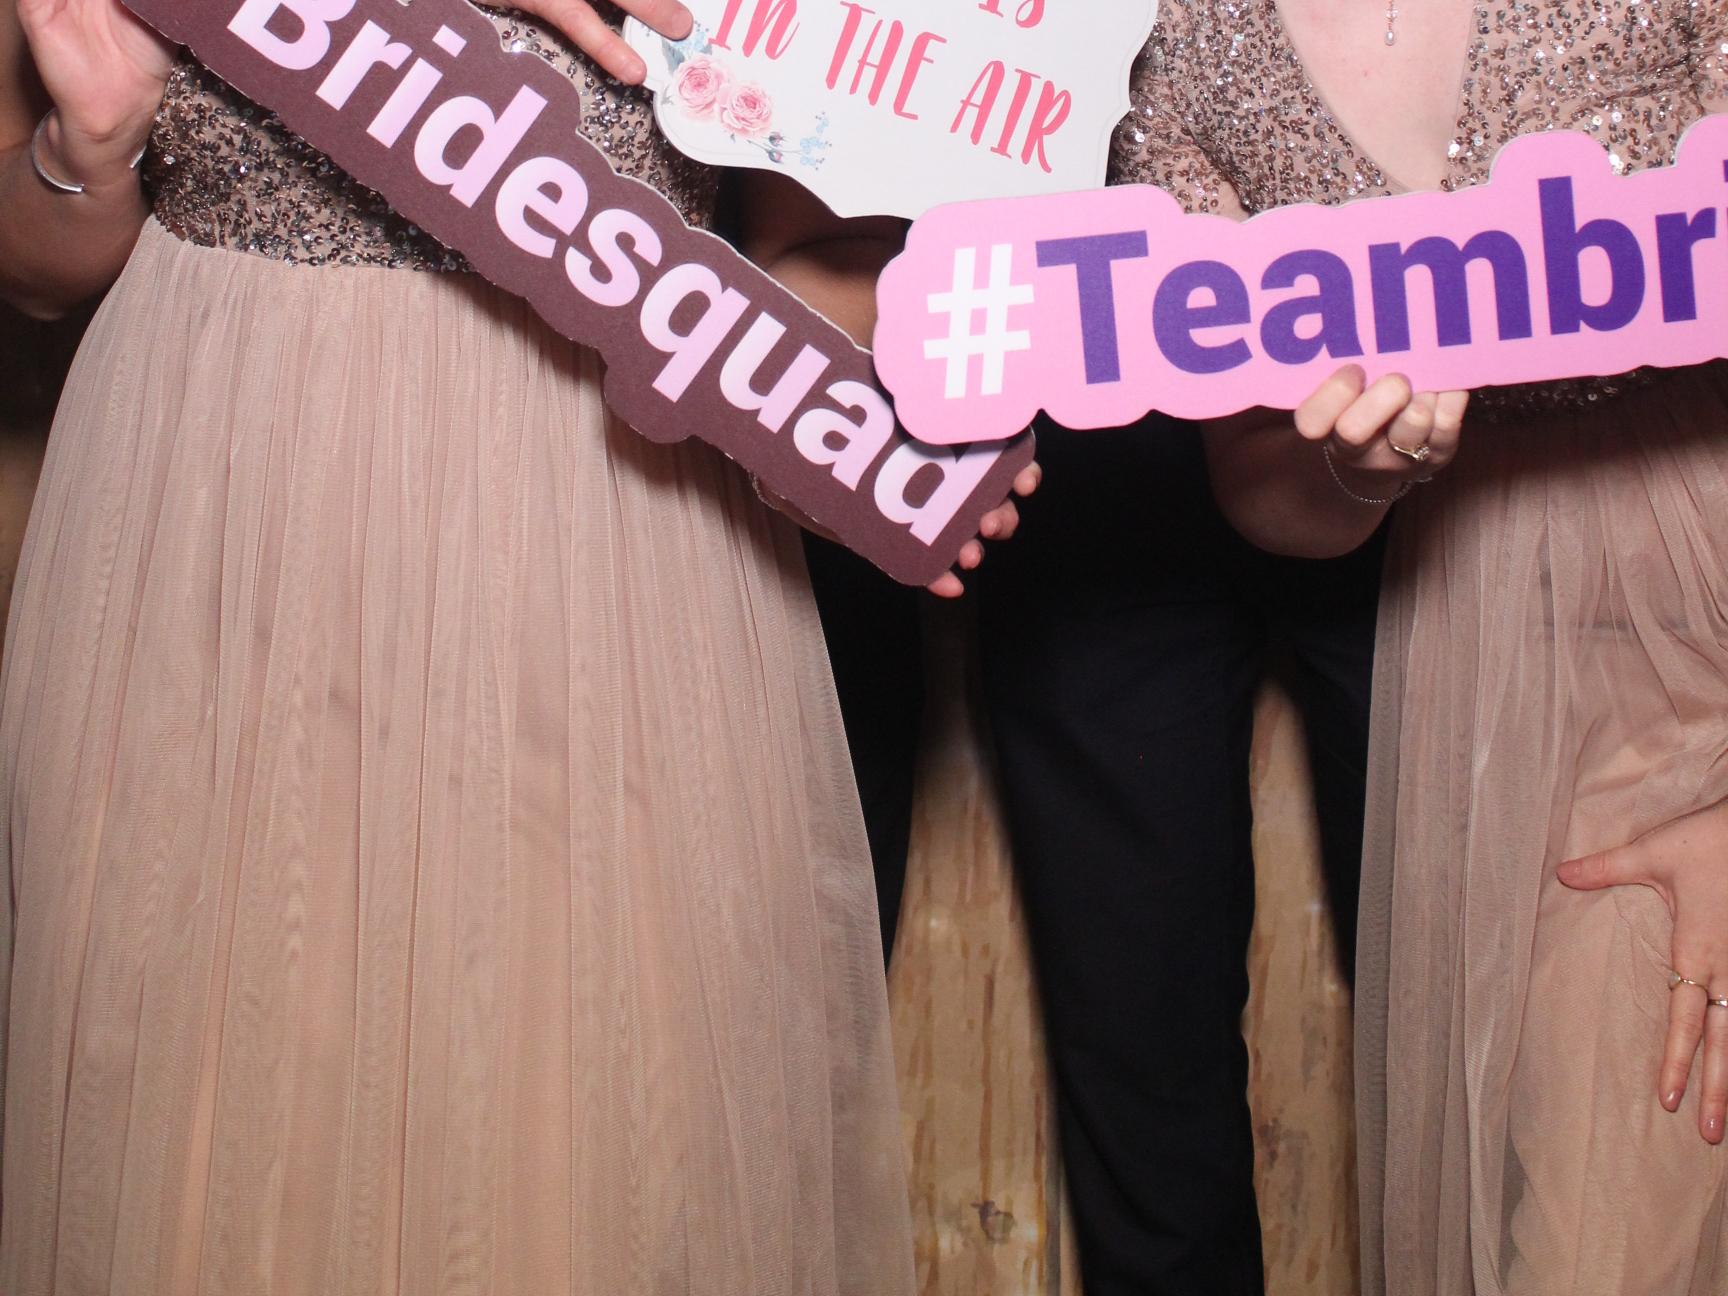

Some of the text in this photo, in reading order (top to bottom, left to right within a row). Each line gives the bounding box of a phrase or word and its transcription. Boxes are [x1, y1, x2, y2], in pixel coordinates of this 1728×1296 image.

[825, 1, 947, 121] THE
[949, 59, 1072, 174] AIR
[923, 159, 1728, 401] #Teambr
